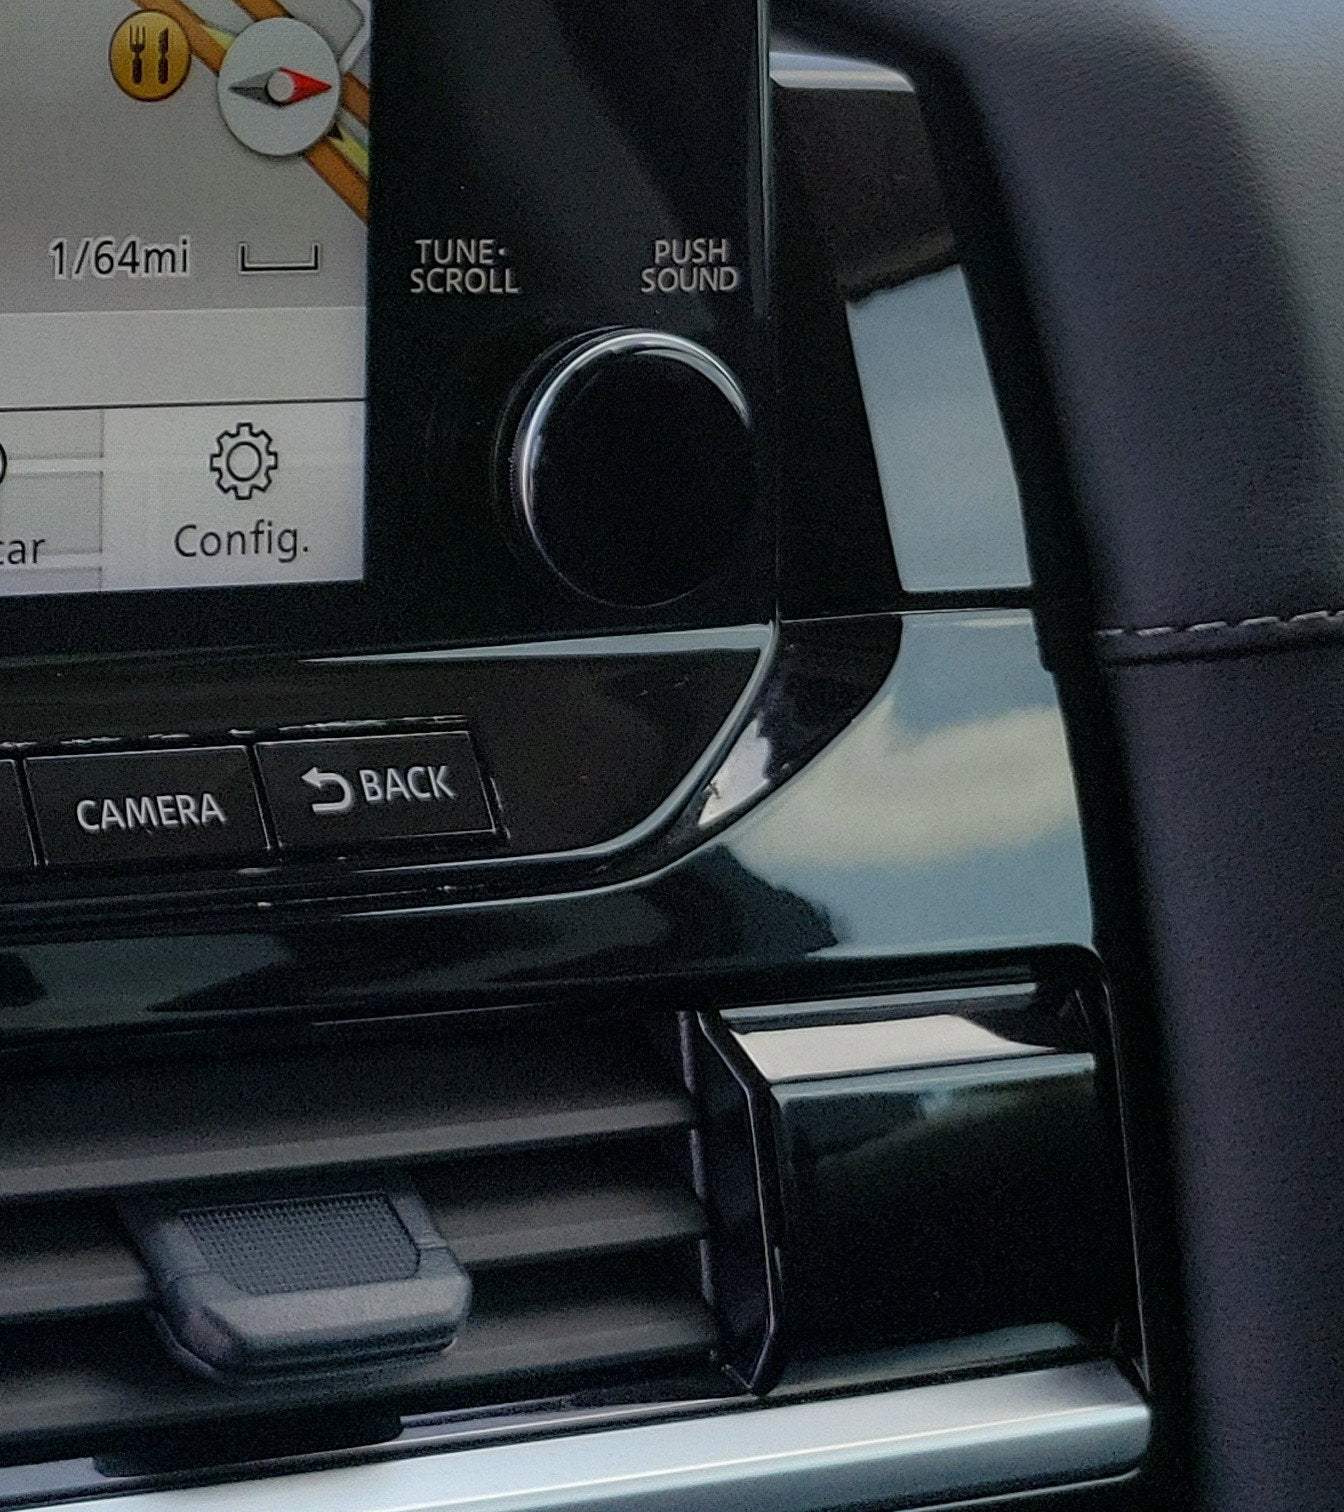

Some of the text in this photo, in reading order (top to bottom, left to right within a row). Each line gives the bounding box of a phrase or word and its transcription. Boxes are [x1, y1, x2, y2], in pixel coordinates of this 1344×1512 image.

[51, 238, 191, 276] 1/64mi
[654, 238, 728, 265] PUSH
[410, 267, 520, 294] SCROLL
[641, 266, 739, 293] SOUND
[174, 519, 310, 564] Config.
[359, 764, 455, 804] BACK
[75, 792, 227, 834] CAMERA
